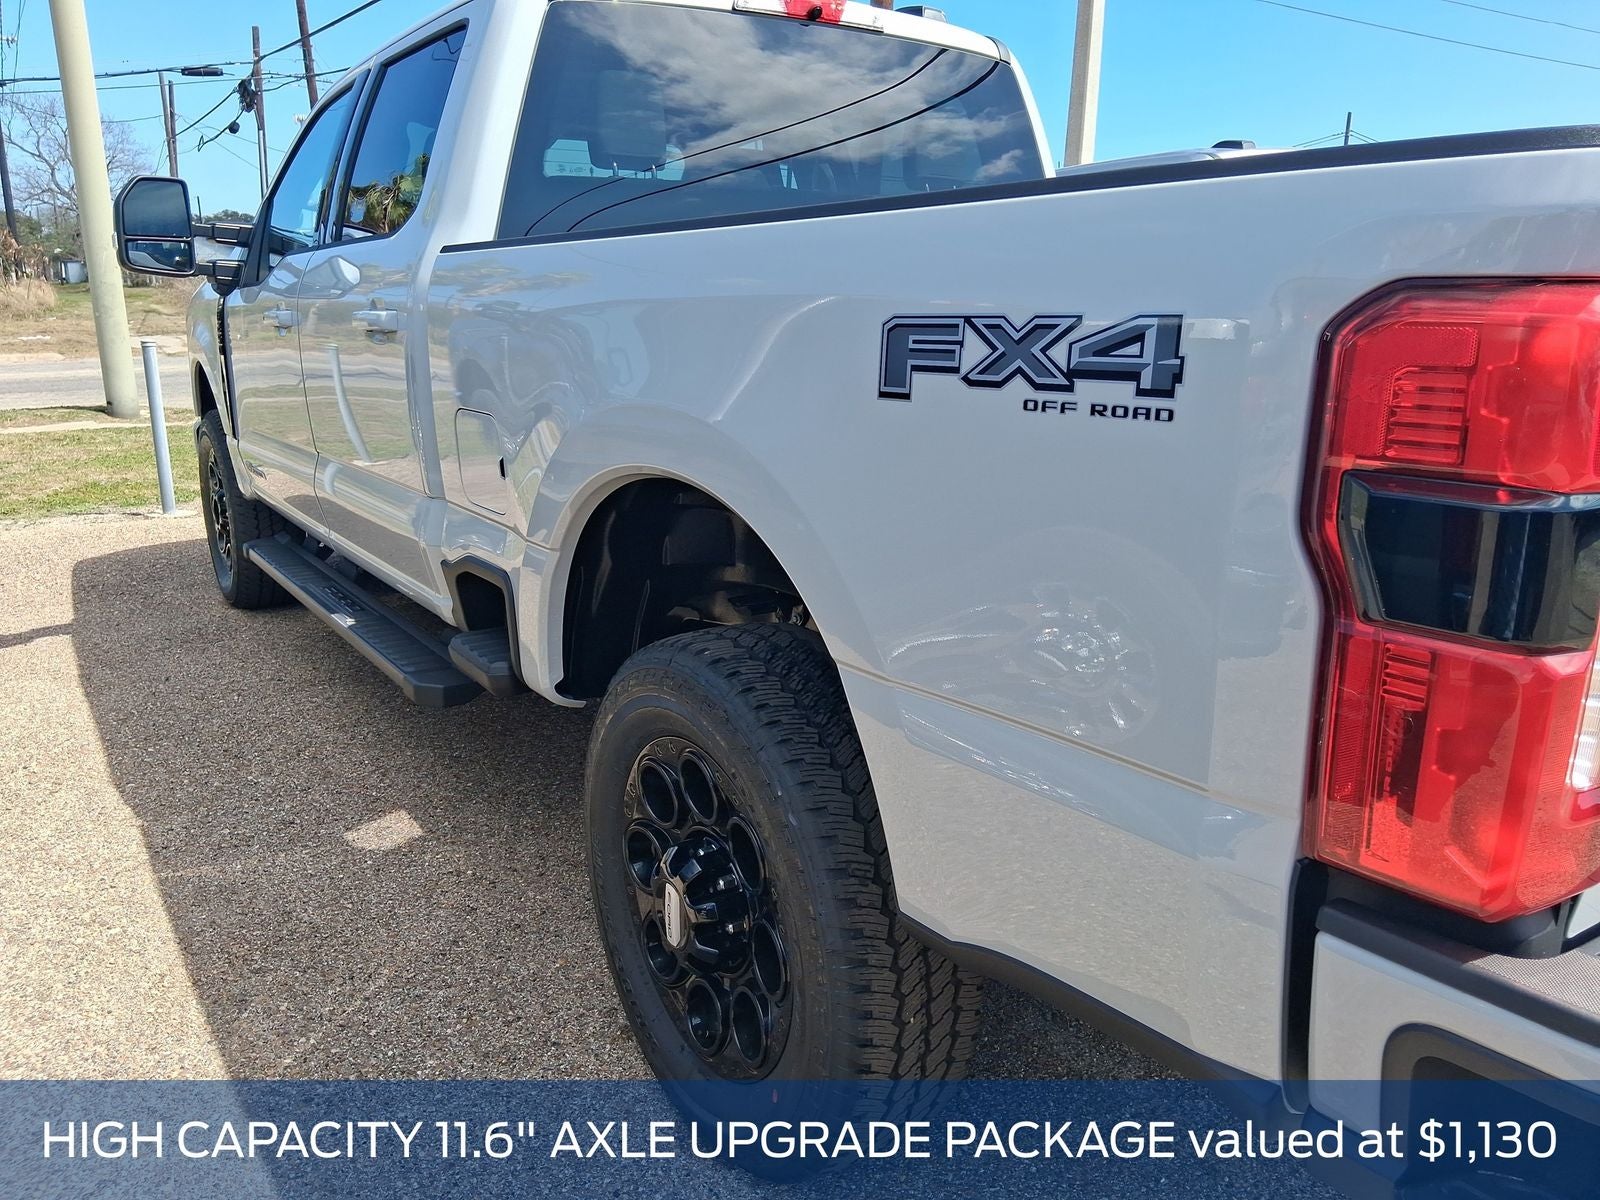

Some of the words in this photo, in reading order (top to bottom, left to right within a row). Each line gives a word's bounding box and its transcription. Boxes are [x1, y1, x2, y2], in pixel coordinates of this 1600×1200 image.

[878, 313, 1186, 401] FX4
[1023, 399, 1077, 415] OFF
[1090, 403, 1175, 423] ROAD
